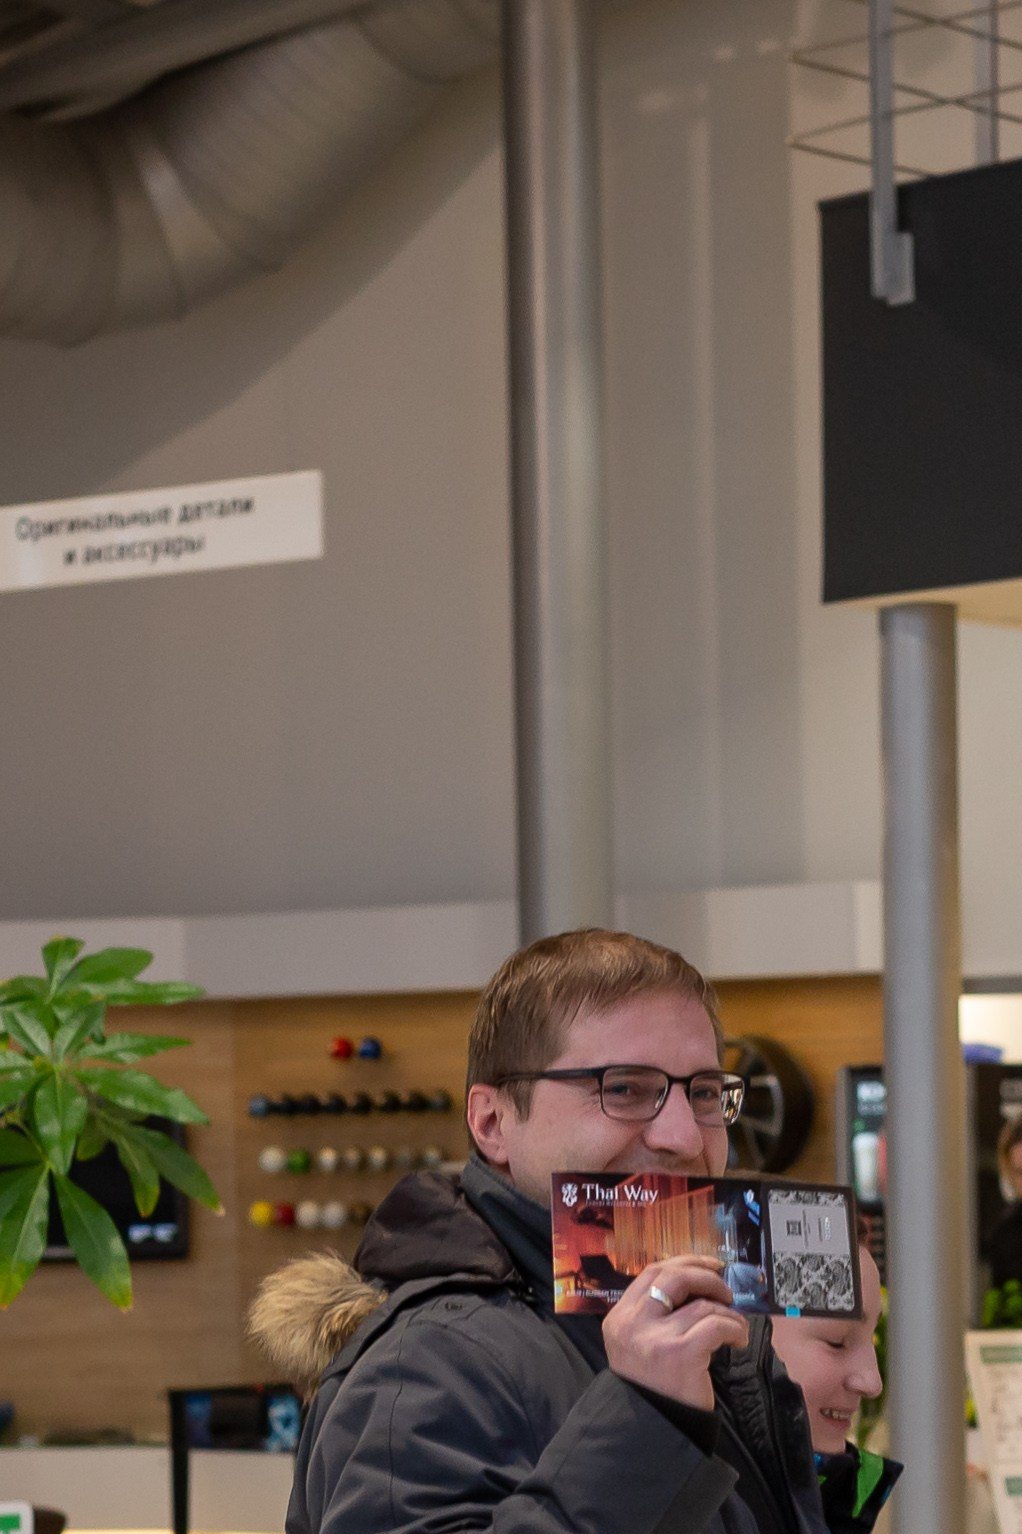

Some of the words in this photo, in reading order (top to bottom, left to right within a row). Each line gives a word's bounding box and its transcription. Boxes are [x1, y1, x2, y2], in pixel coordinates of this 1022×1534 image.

[16, 508, 170, 542] Оригинальные
[179, 499, 254, 523] детали
[62, 549, 77, 565] и
[84, 537, 203, 563] аксессуары
[581, 1183, 619, 1201] Thai
[623, 1184, 659, 1205] Way
